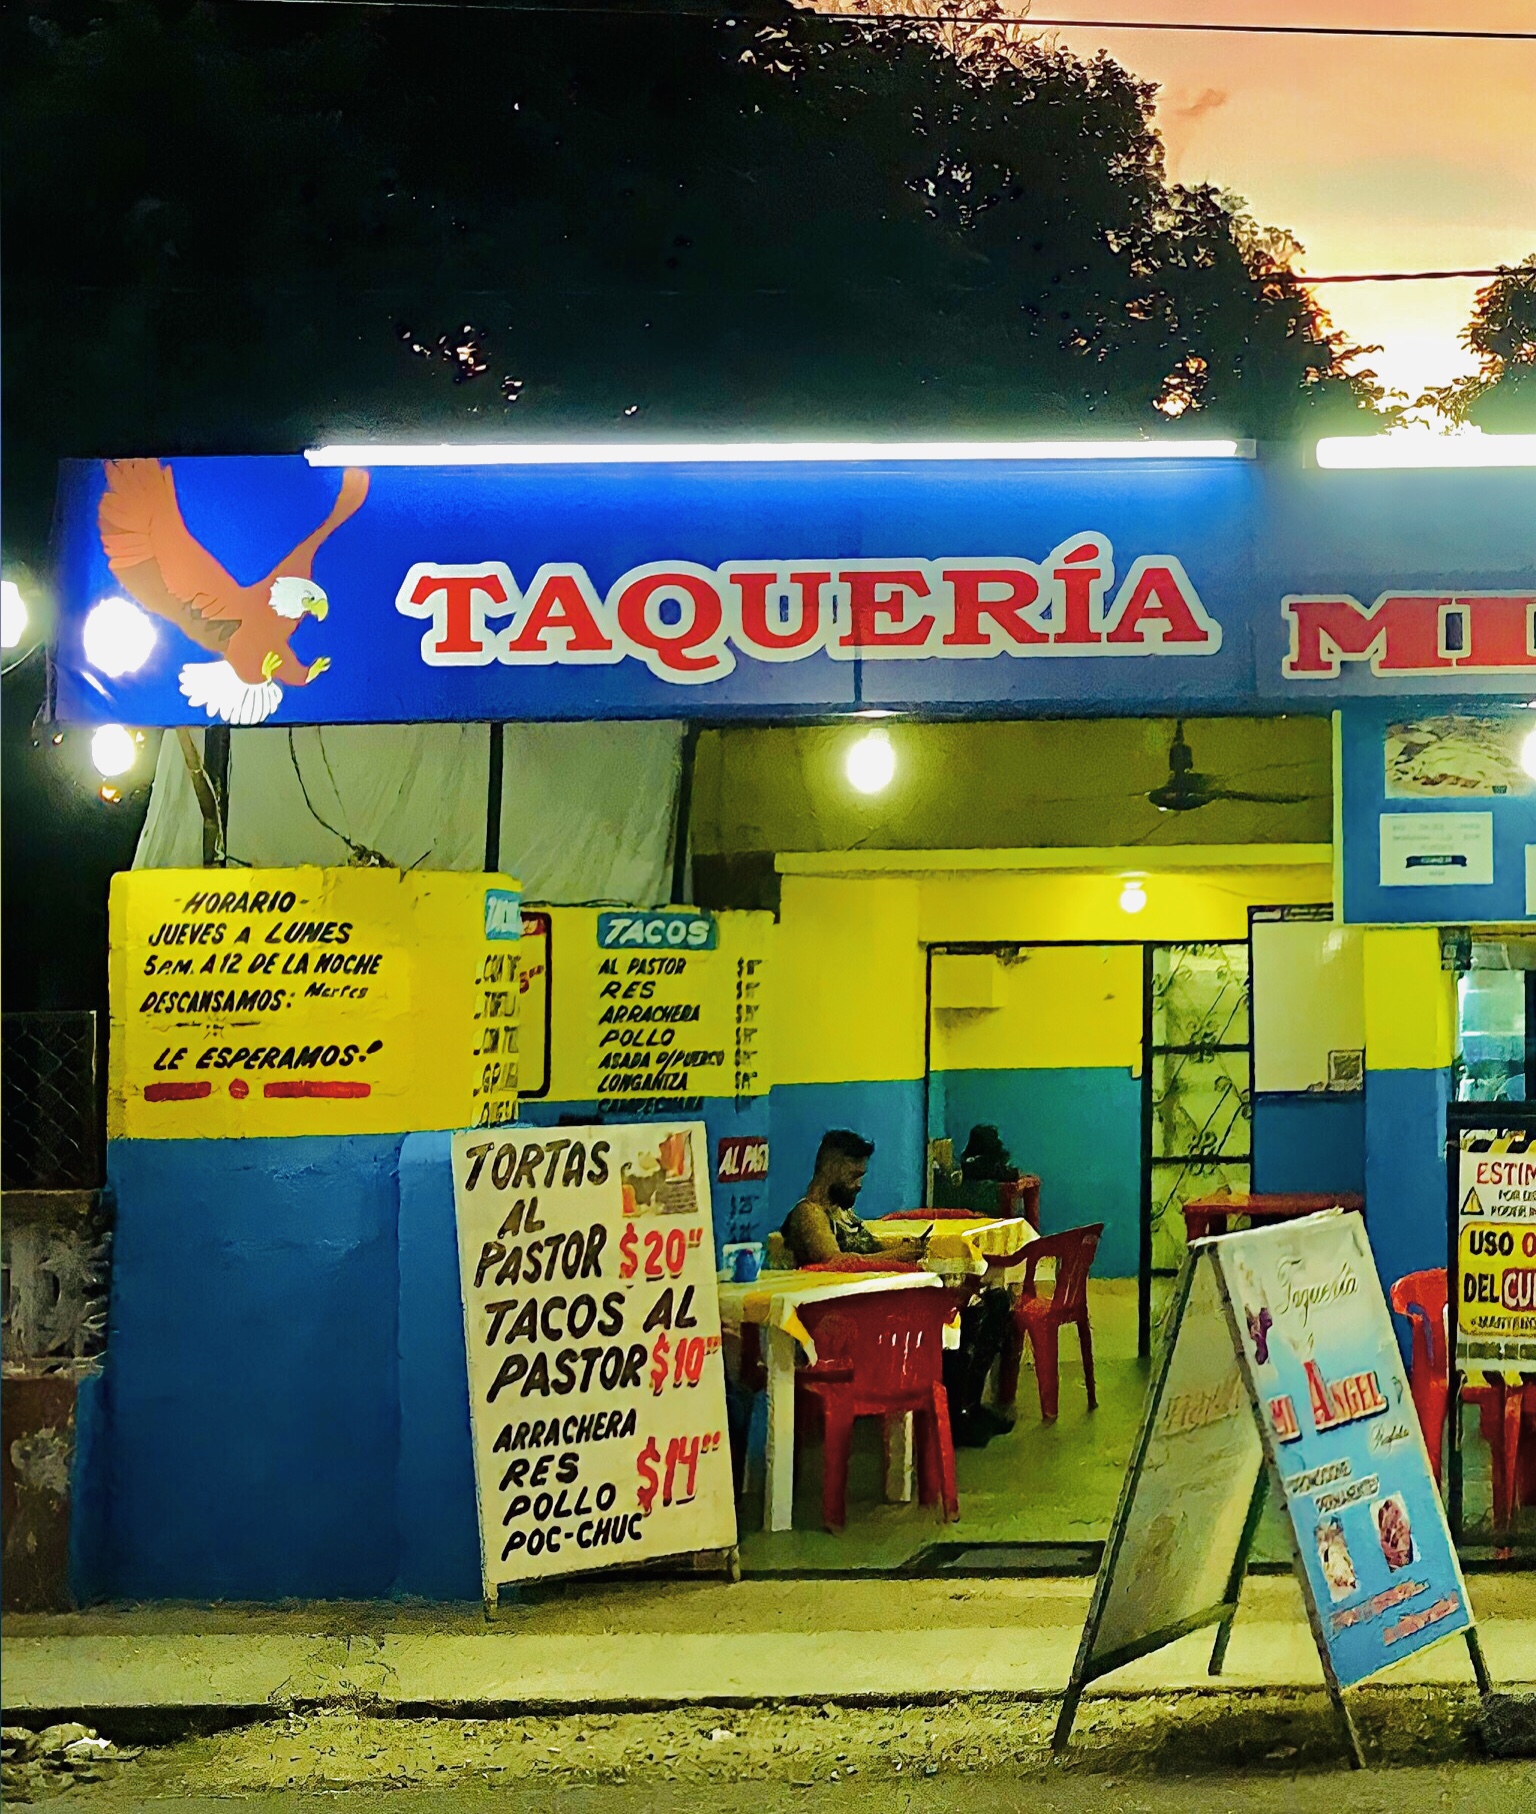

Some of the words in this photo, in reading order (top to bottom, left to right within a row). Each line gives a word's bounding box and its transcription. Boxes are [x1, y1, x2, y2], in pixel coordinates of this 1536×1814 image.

[395, 530, 1222, 685] TAQUERÍA
[182, 891, 296, 914] HORARIO
[148, 923, 227, 946] JUEVES
[234, 926, 251, 945] A
[264, 921, 353, 944] LUNES
[605, 917, 710, 946] TACOS
[200, 953, 217, 974] A
[219, 953, 243, 974] 12
[247, 952, 280, 974] DE
[281, 952, 309, 975] LA
[313, 953, 383, 975] NOCHE
[598, 957, 618, 975] AL
[627, 957, 687, 976] PASTOR
[599, 980, 656, 999] RES
[598, 1004, 700, 1026] ARRACHERA
[599, 1028, 675, 1047] POLLO
[153, 1046, 188, 1071] LE
[598, 1051, 650, 1069] ASADA
[597, 1072, 688, 1093] LONGANIZA
[465, 1138, 612, 1191] TORTAS
[718, 1145, 740, 1176] AL
[497, 1195, 546, 1240] AL
[473, 1223, 608, 1288] PASTOR
[1469, 1230, 1514, 1256] USO
[1463, 1272, 1500, 1303] DEL
[484, 1291, 627, 1347] TACOS
[642, 1284, 698, 1334] AL
[486, 1342, 648, 1404] PASTOR
[492, 1407, 638, 1453] ARRACHERA
[498, 1452, 580, 1492] RES
[502, 1482, 617, 1527] POLLO
[500, 1512, 643, 1562] POC-CHUC
